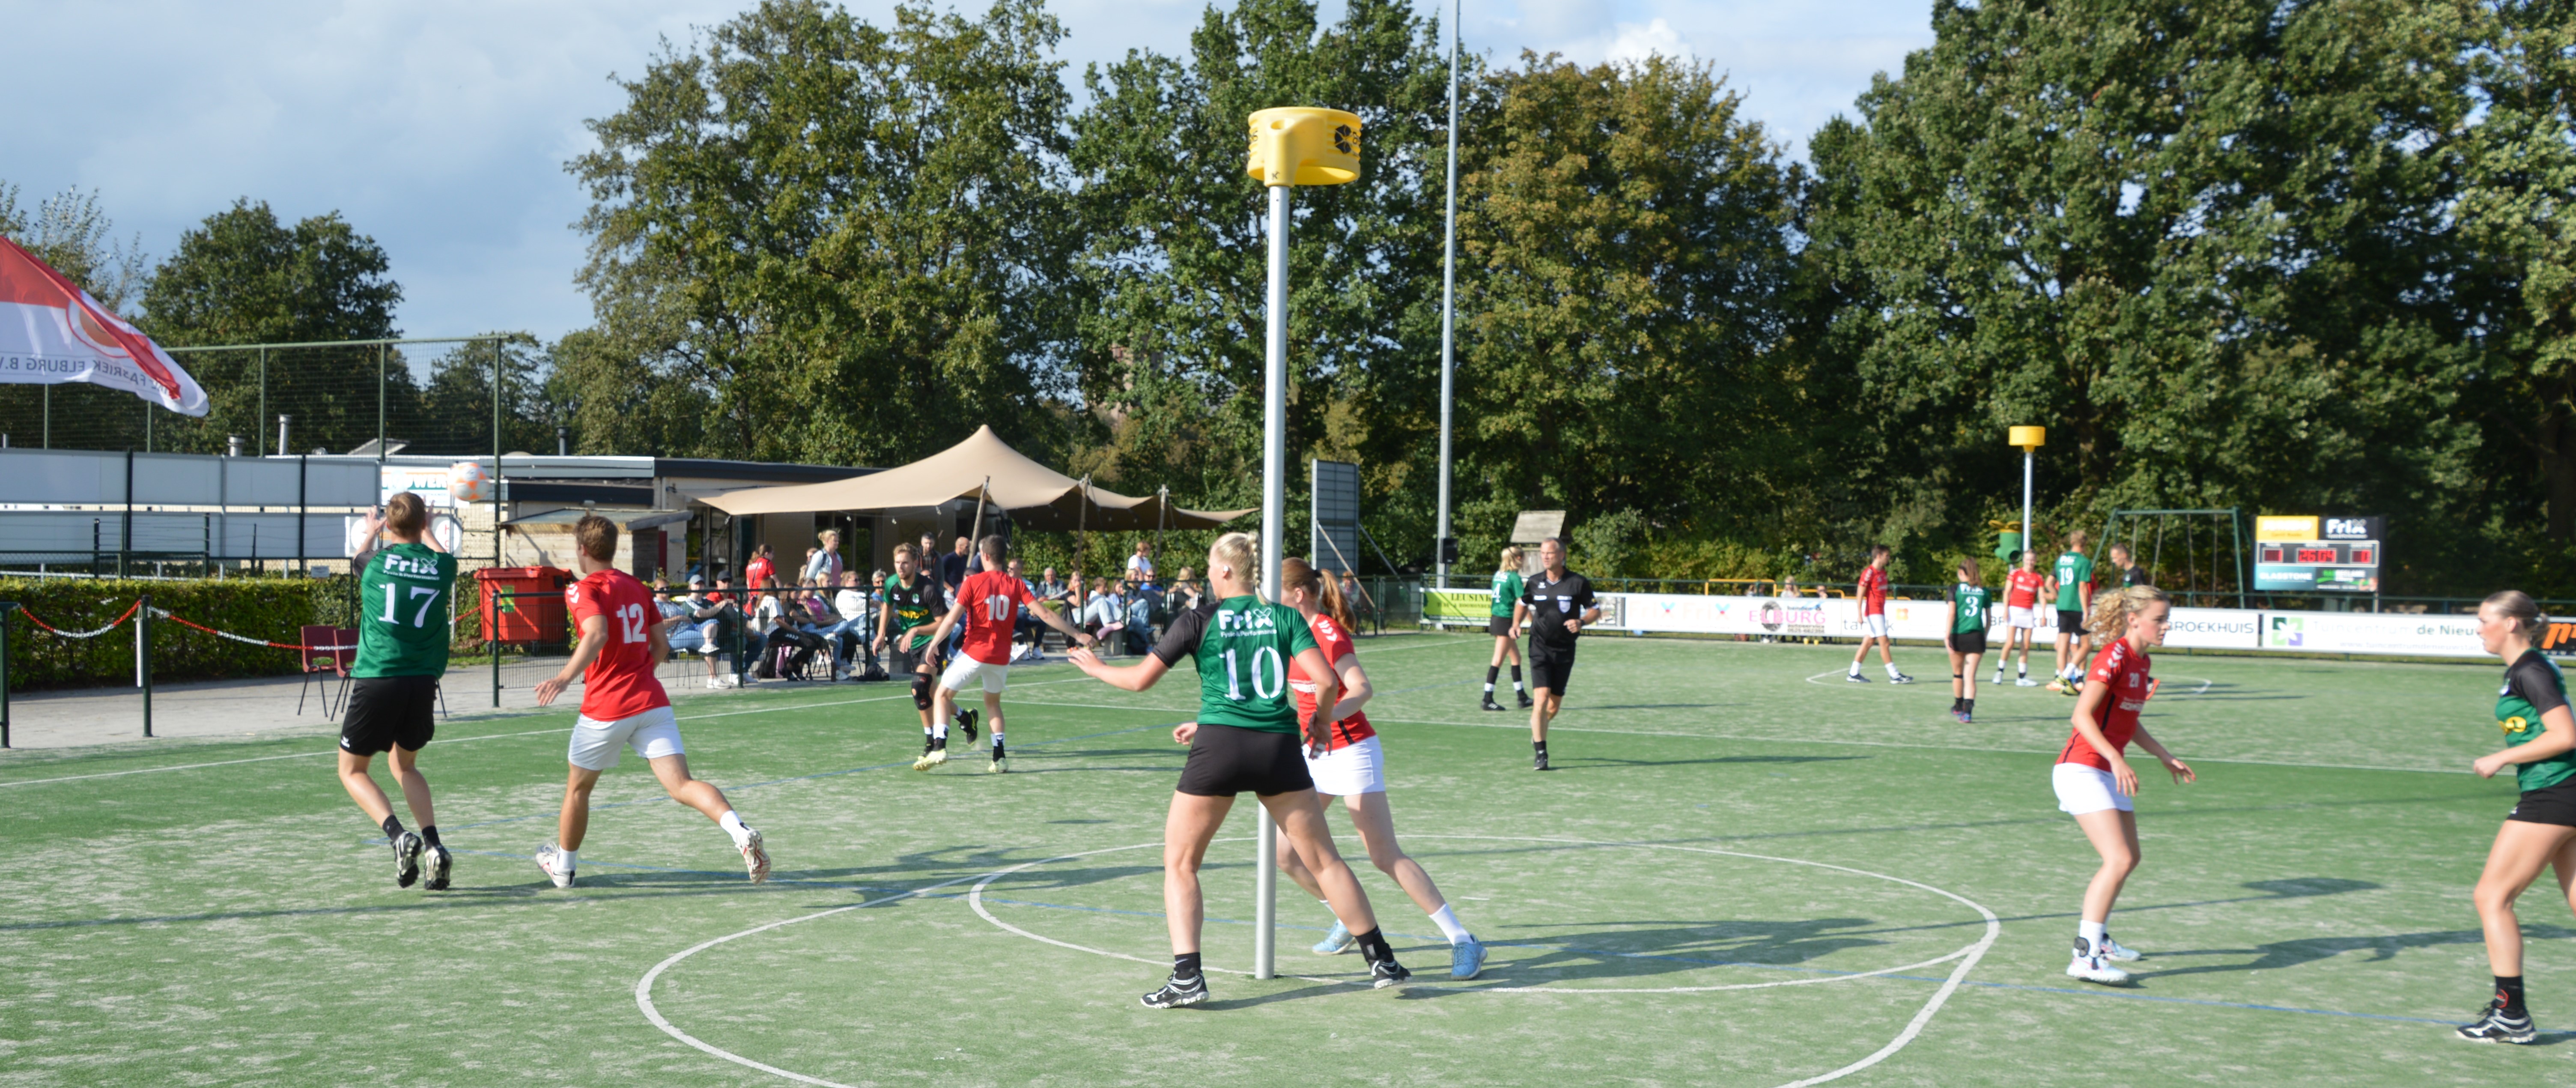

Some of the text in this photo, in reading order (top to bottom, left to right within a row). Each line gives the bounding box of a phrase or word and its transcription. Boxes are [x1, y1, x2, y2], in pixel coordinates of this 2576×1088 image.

[2059, 567, 2074, 586] 19
[1492, 583, 1501, 603] 4
[379, 583, 440, 628] 17
[984, 595, 1010, 621] 10
[1965, 596, 1978, 617] 3
[617, 603, 647, 643] 12
[1749, 609, 1826, 624] ELBURG
[2313, 621, 2478, 636] Tuincentrum de Nieu
[1219, 646, 1284, 701] 10
[2129, 672, 2140, 688] 20
